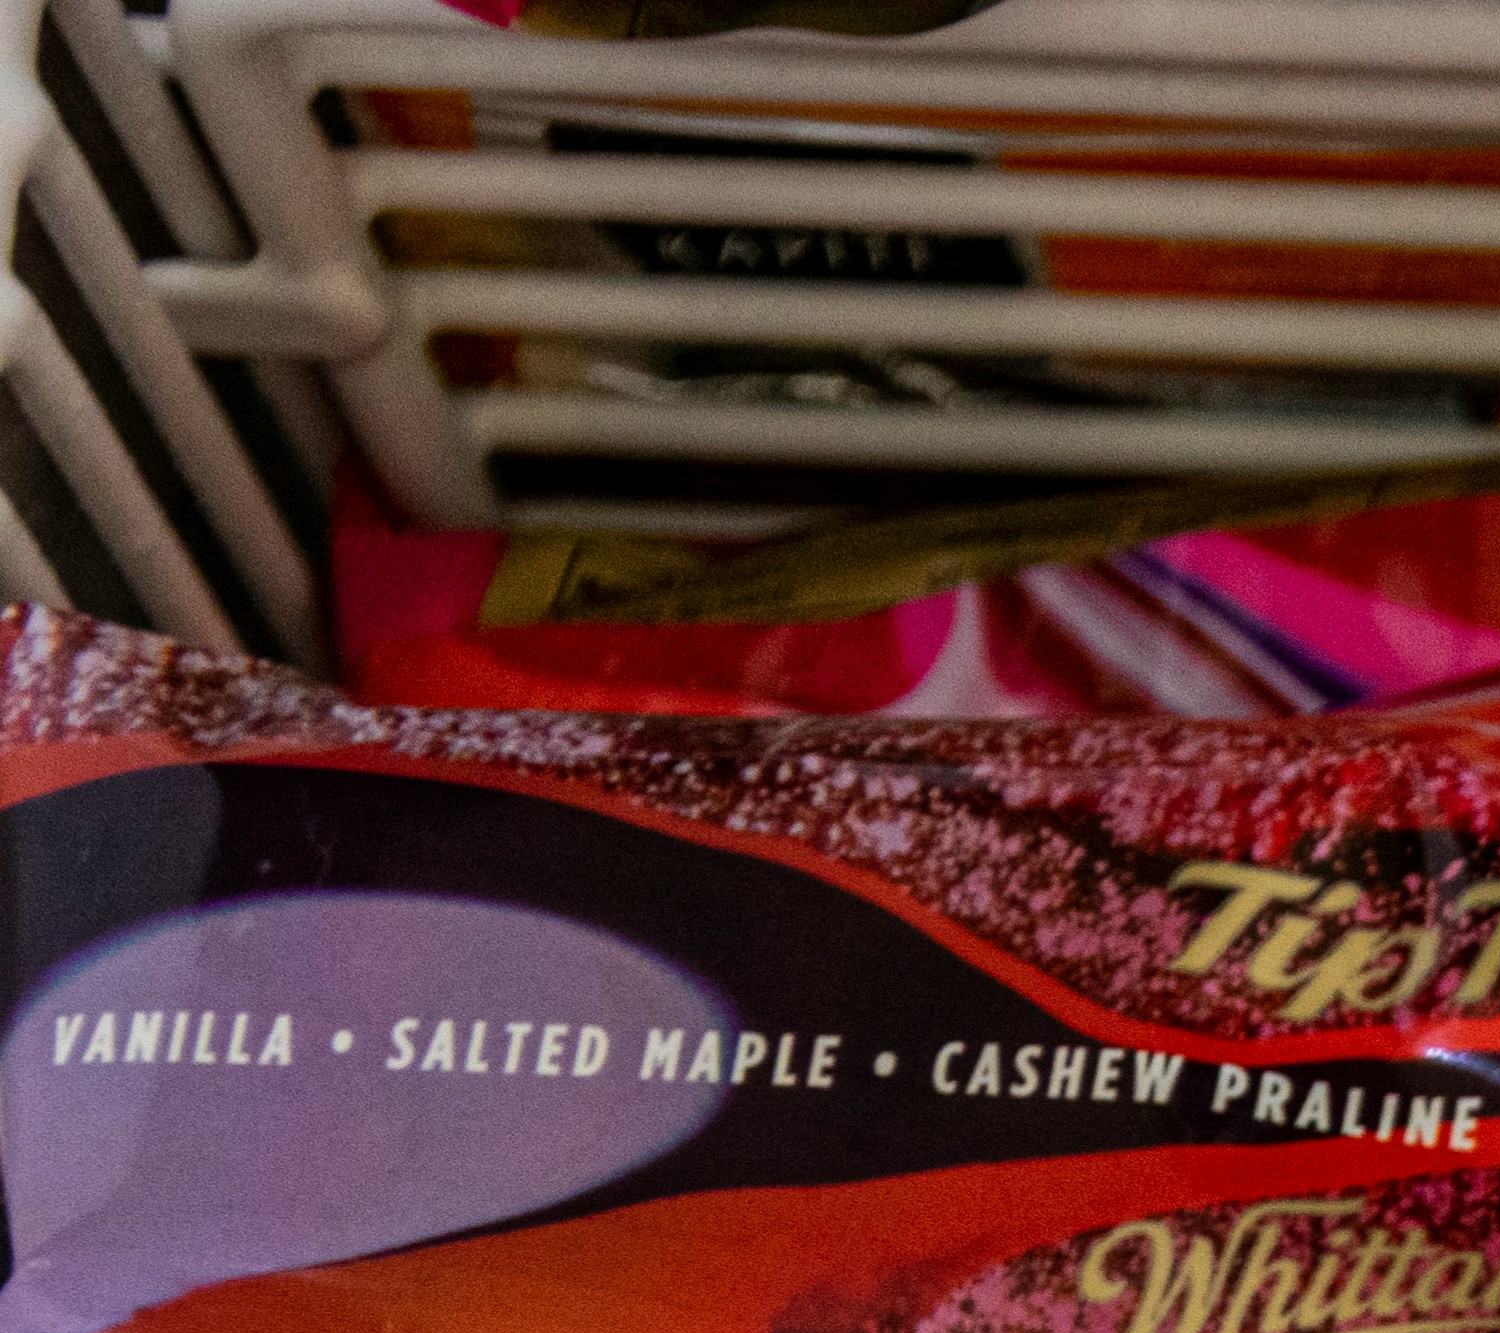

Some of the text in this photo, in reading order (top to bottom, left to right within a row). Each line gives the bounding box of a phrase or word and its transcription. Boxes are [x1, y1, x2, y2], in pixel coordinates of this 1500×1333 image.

[53, 1013, 293, 1066] VANILLA
[387, 1020, 607, 1079] SALTED
[641, 1028, 842, 1089] MAPLE
[932, 1042, 1185, 1105] CASHEW
[1211, 1064, 1482, 1151] PRALINE
